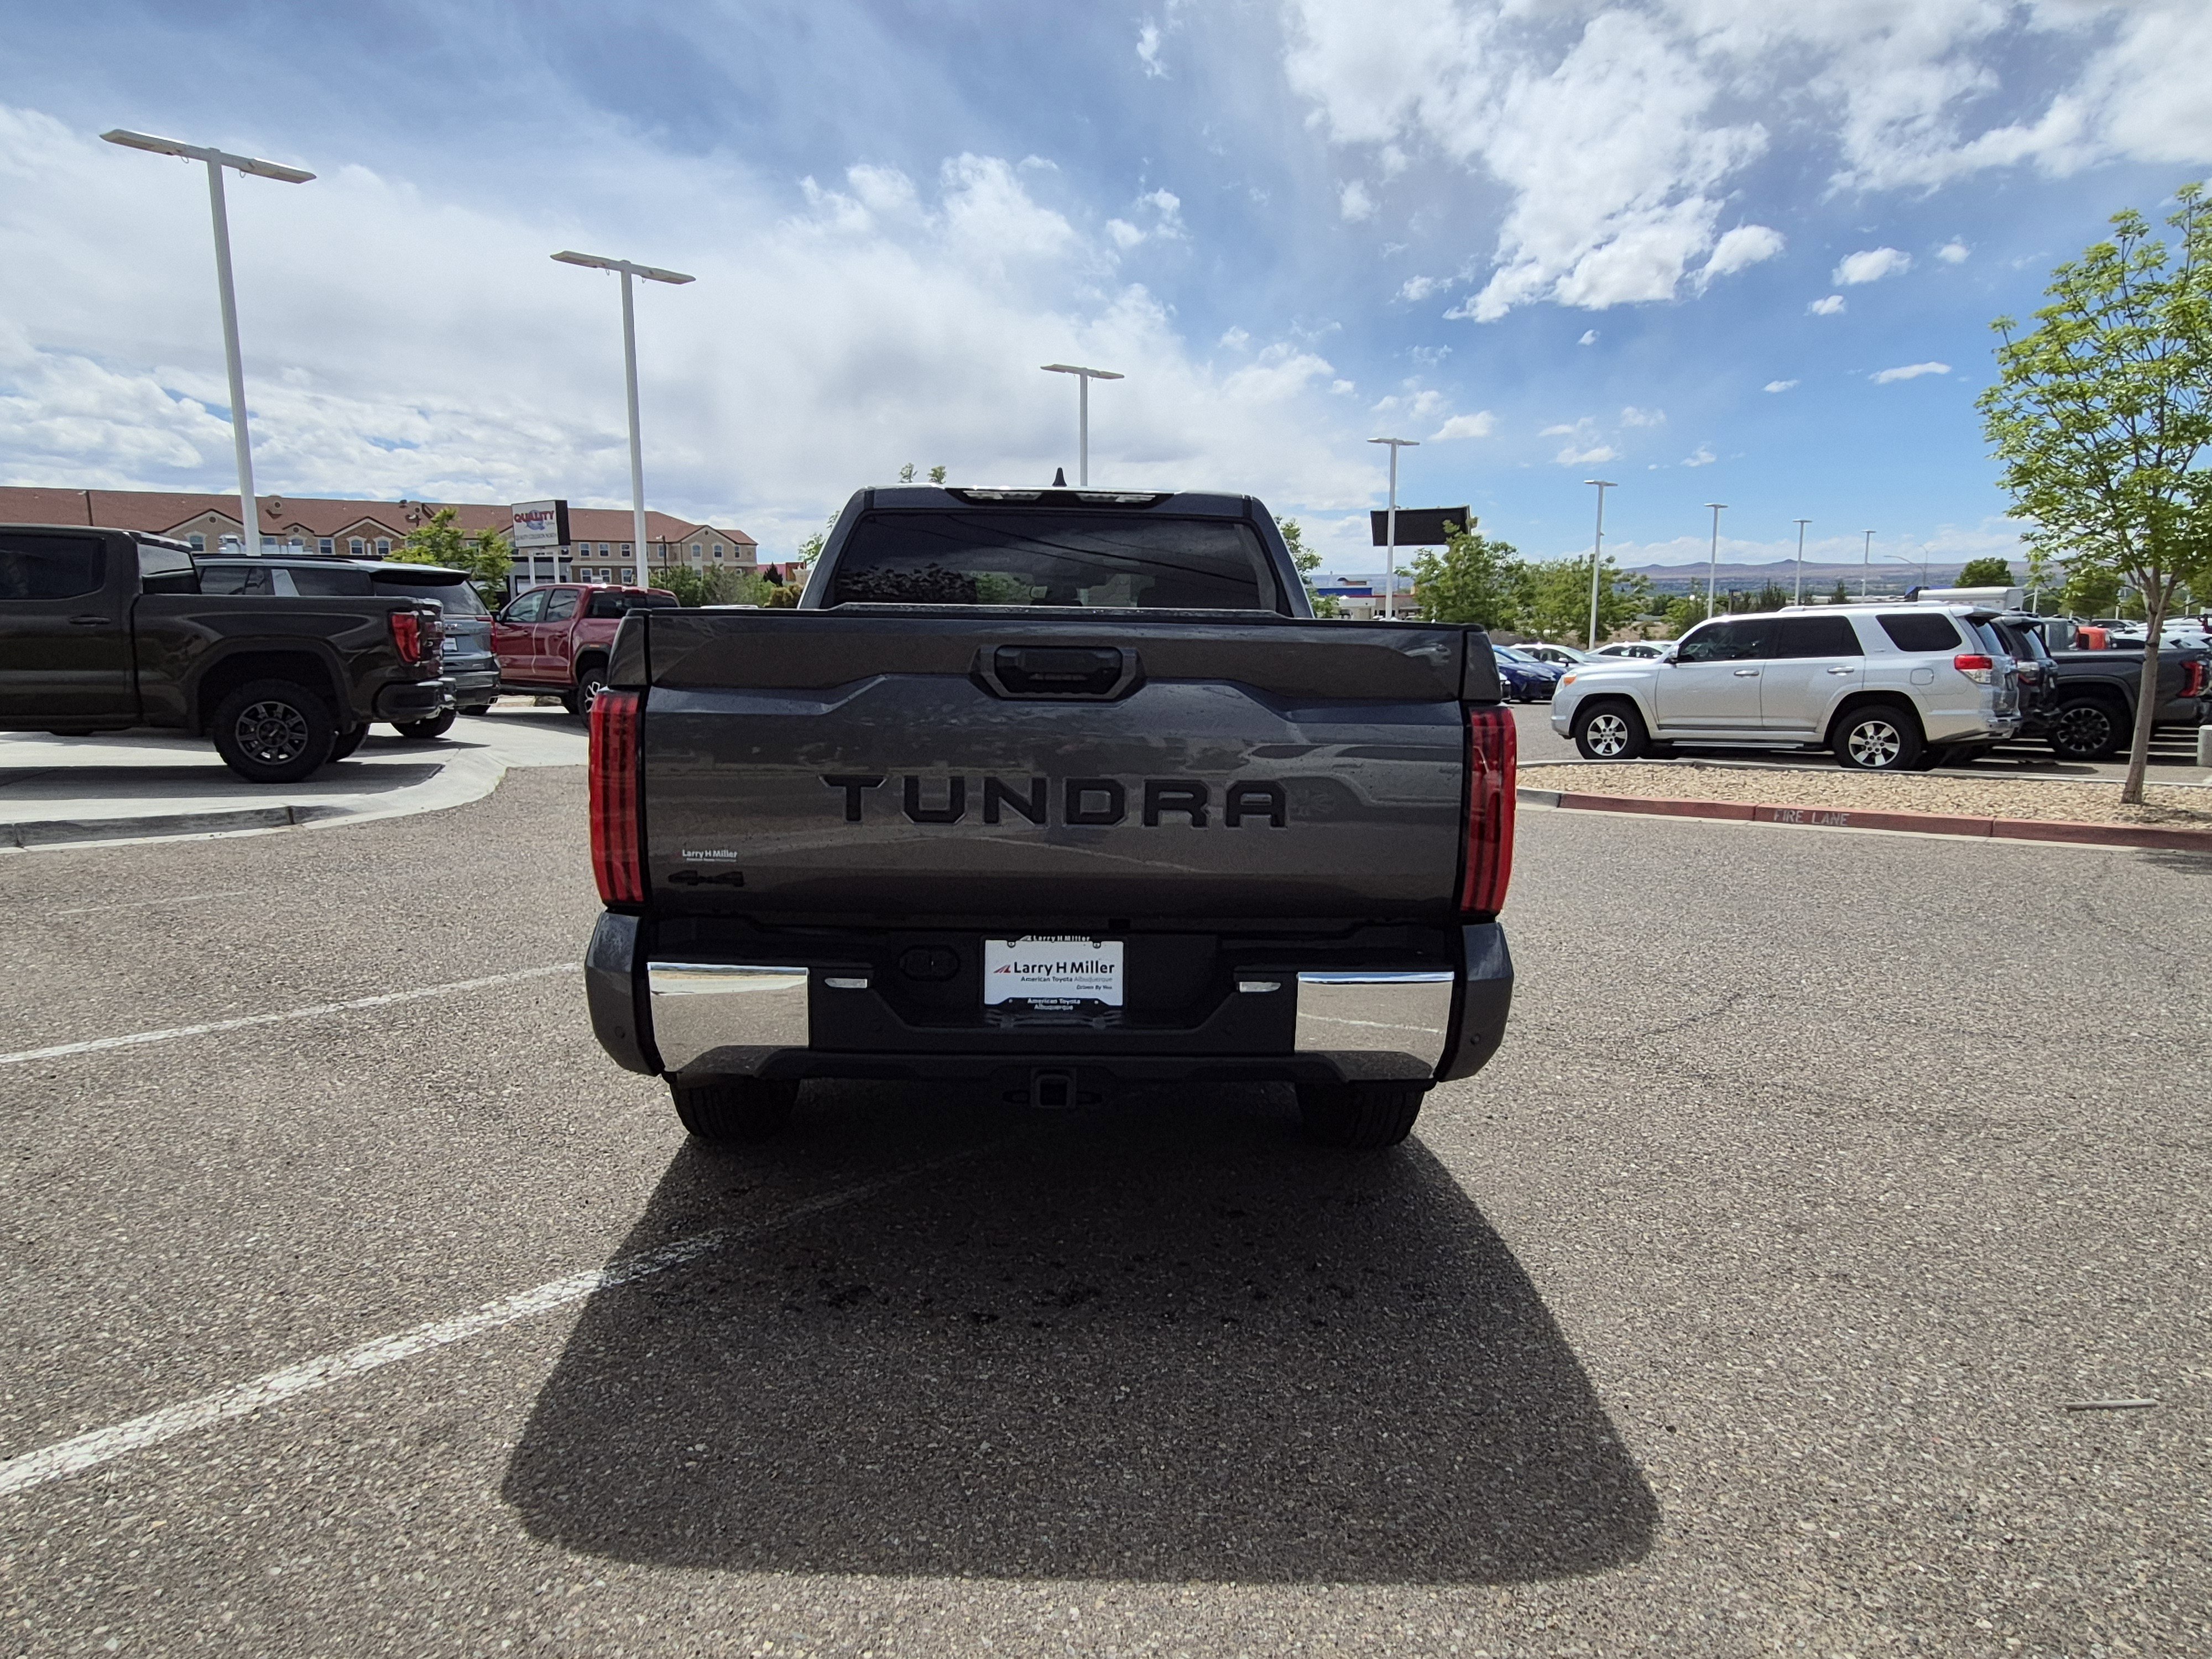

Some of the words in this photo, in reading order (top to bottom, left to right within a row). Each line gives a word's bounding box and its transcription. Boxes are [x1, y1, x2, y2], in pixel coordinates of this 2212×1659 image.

[514, 510, 554, 523] QUALITY
[818, 775, 1288, 828] TUNDRA
[1773, 808, 1804, 823] FIRE
[1812, 812, 1850, 826] LANE
[682, 849, 703, 859] Larry
[712, 849, 738, 858] Miller
[1014, 962, 1052, 975] Larry
[1056, 962, 1067, 973] H
[1071, 961, 1115, 973] Miller
[1059, 998, 1081, 1006] Toyota
